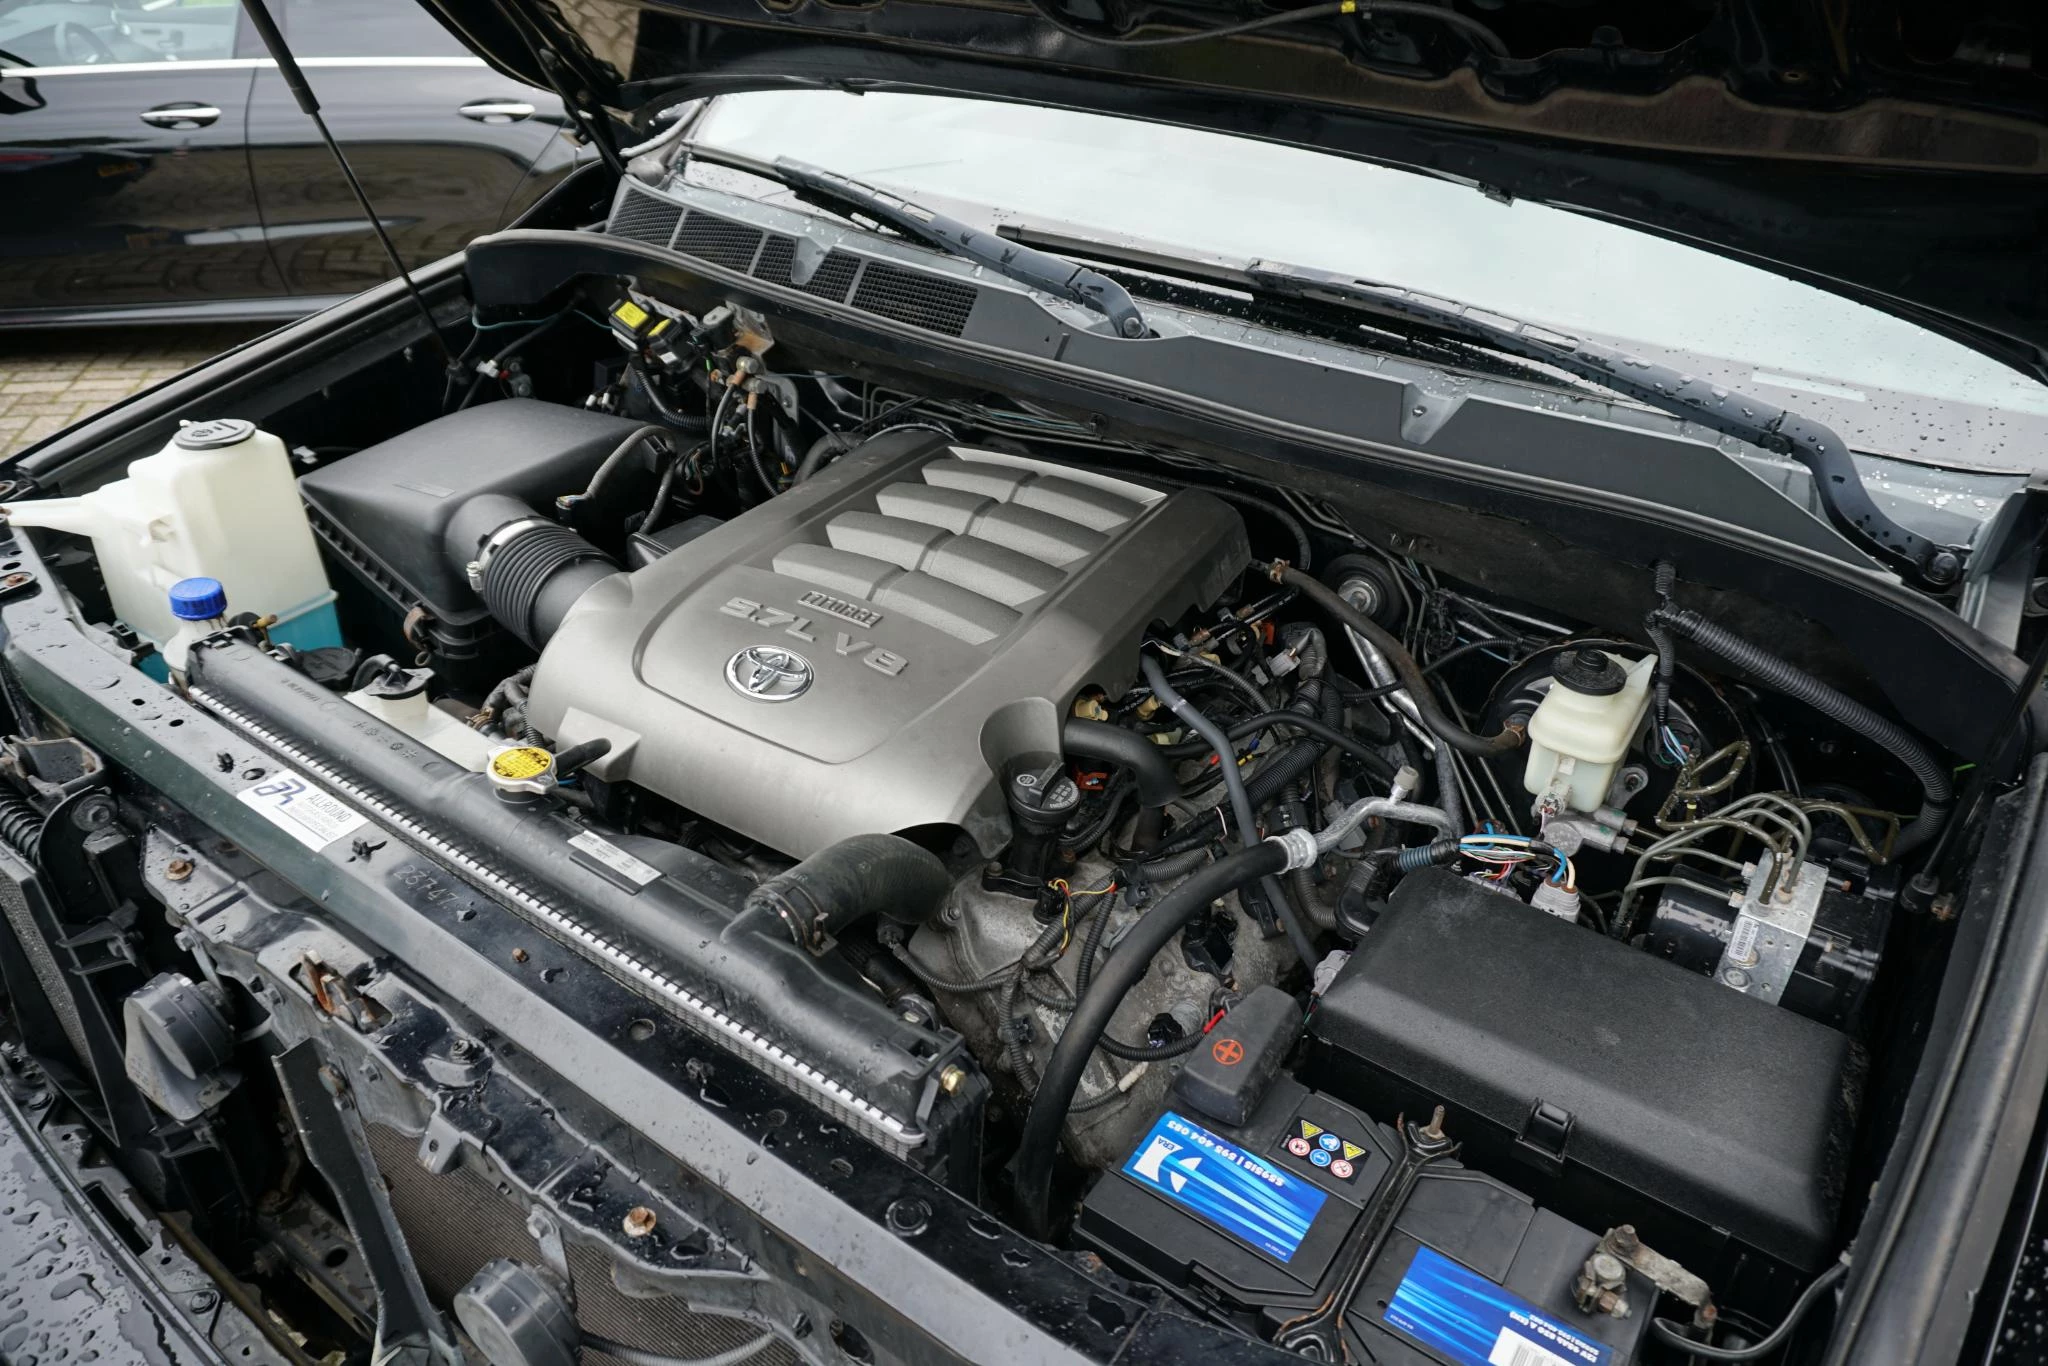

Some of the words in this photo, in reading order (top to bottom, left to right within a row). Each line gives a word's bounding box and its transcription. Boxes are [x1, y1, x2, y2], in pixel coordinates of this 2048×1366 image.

[720, 597, 816, 642] 5.7L
[836, 632, 909, 677] V8
[307, 793, 353, 823] ALLROUND
[1157, 1137, 1175, 1151] ERA
[1190, 1132, 1213, 1149] 404
[1214, 1144, 1236, 1161] 595
